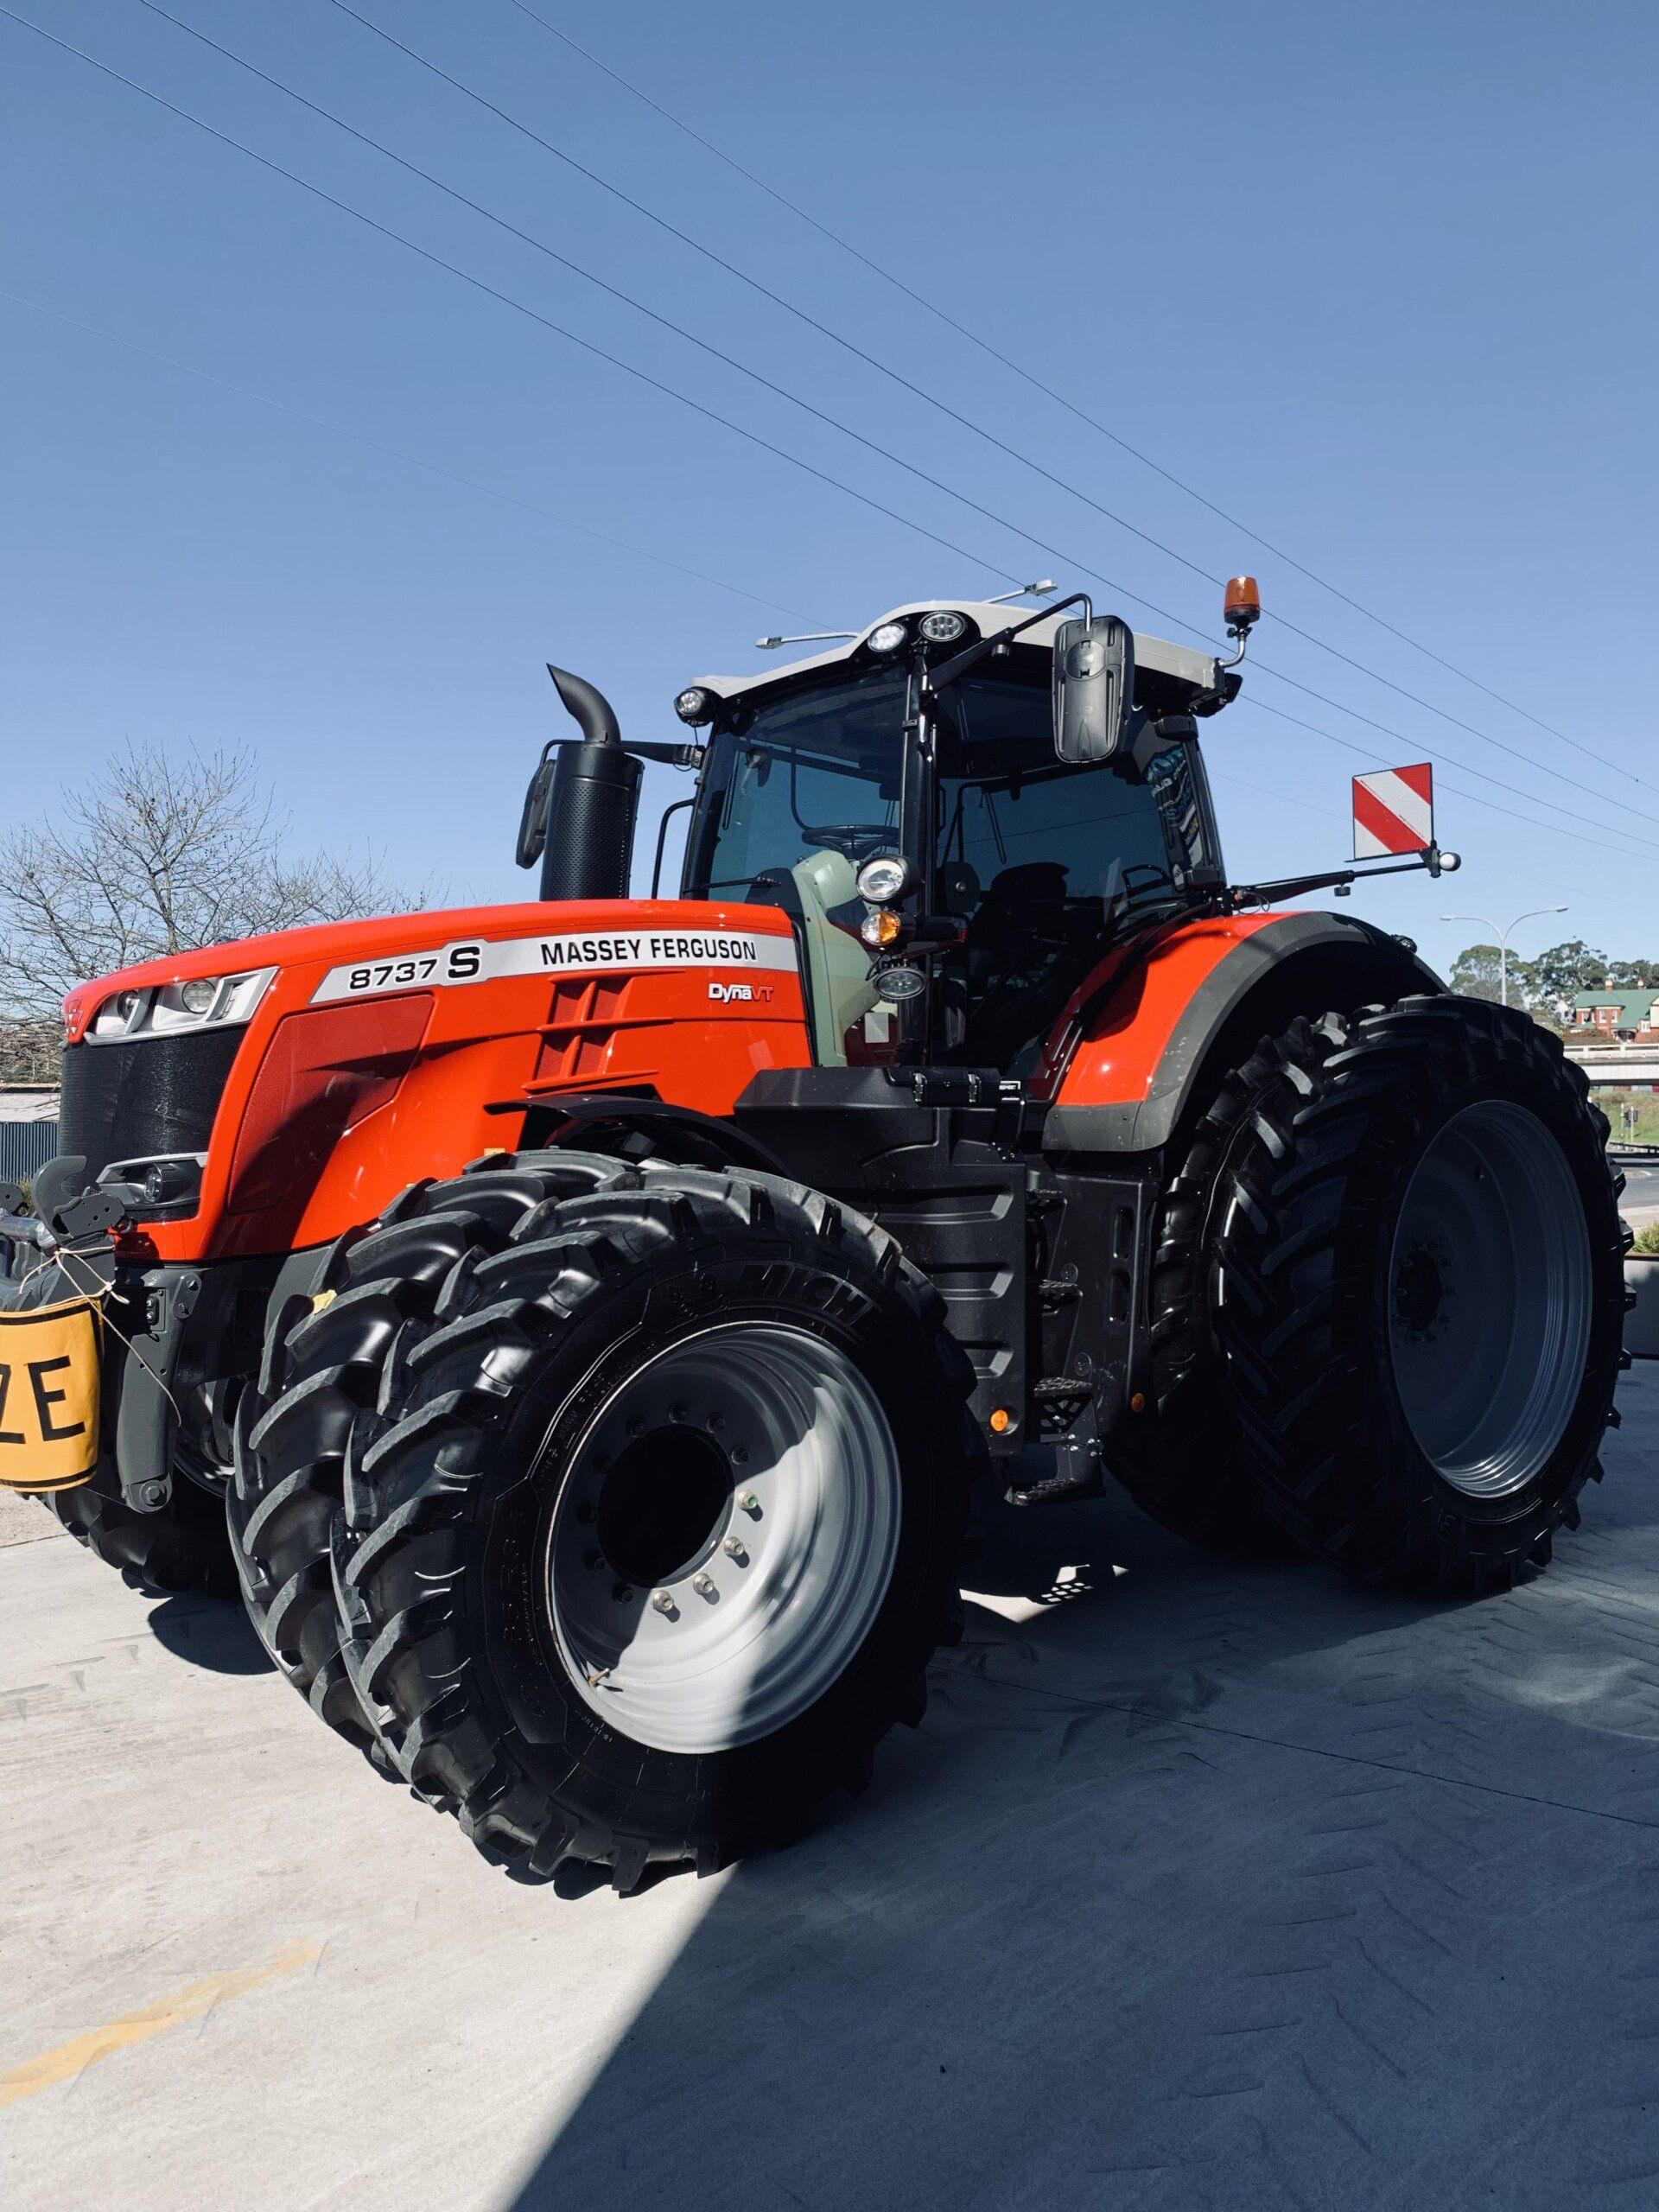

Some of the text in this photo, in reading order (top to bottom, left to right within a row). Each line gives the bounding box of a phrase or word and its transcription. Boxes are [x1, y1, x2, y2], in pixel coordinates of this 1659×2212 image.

[350, 946, 480, 990] 8737 S
[540, 938, 757, 966] MASSEY FERGUSON
